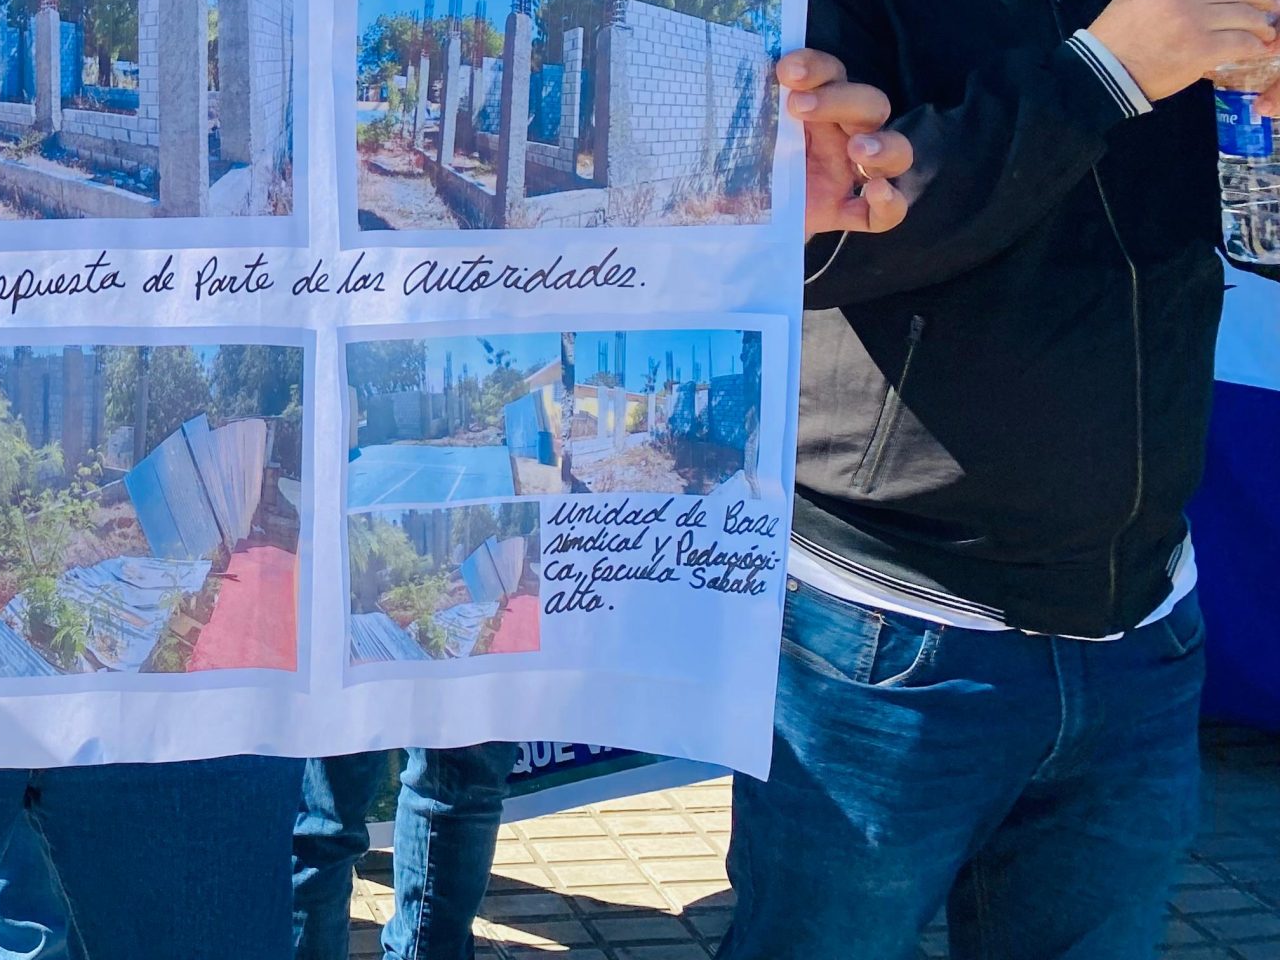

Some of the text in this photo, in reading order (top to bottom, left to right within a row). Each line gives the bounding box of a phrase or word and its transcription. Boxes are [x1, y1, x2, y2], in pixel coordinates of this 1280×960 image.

[142, 254, 175, 294] de
[291, 258, 331, 297] de
[335, 251, 386, 295] las
[675, 498, 707, 527] de
[723, 500, 779, 538] Base
[591, 556, 681, 583] Escuela
[689, 567, 767, 596] Sabana
